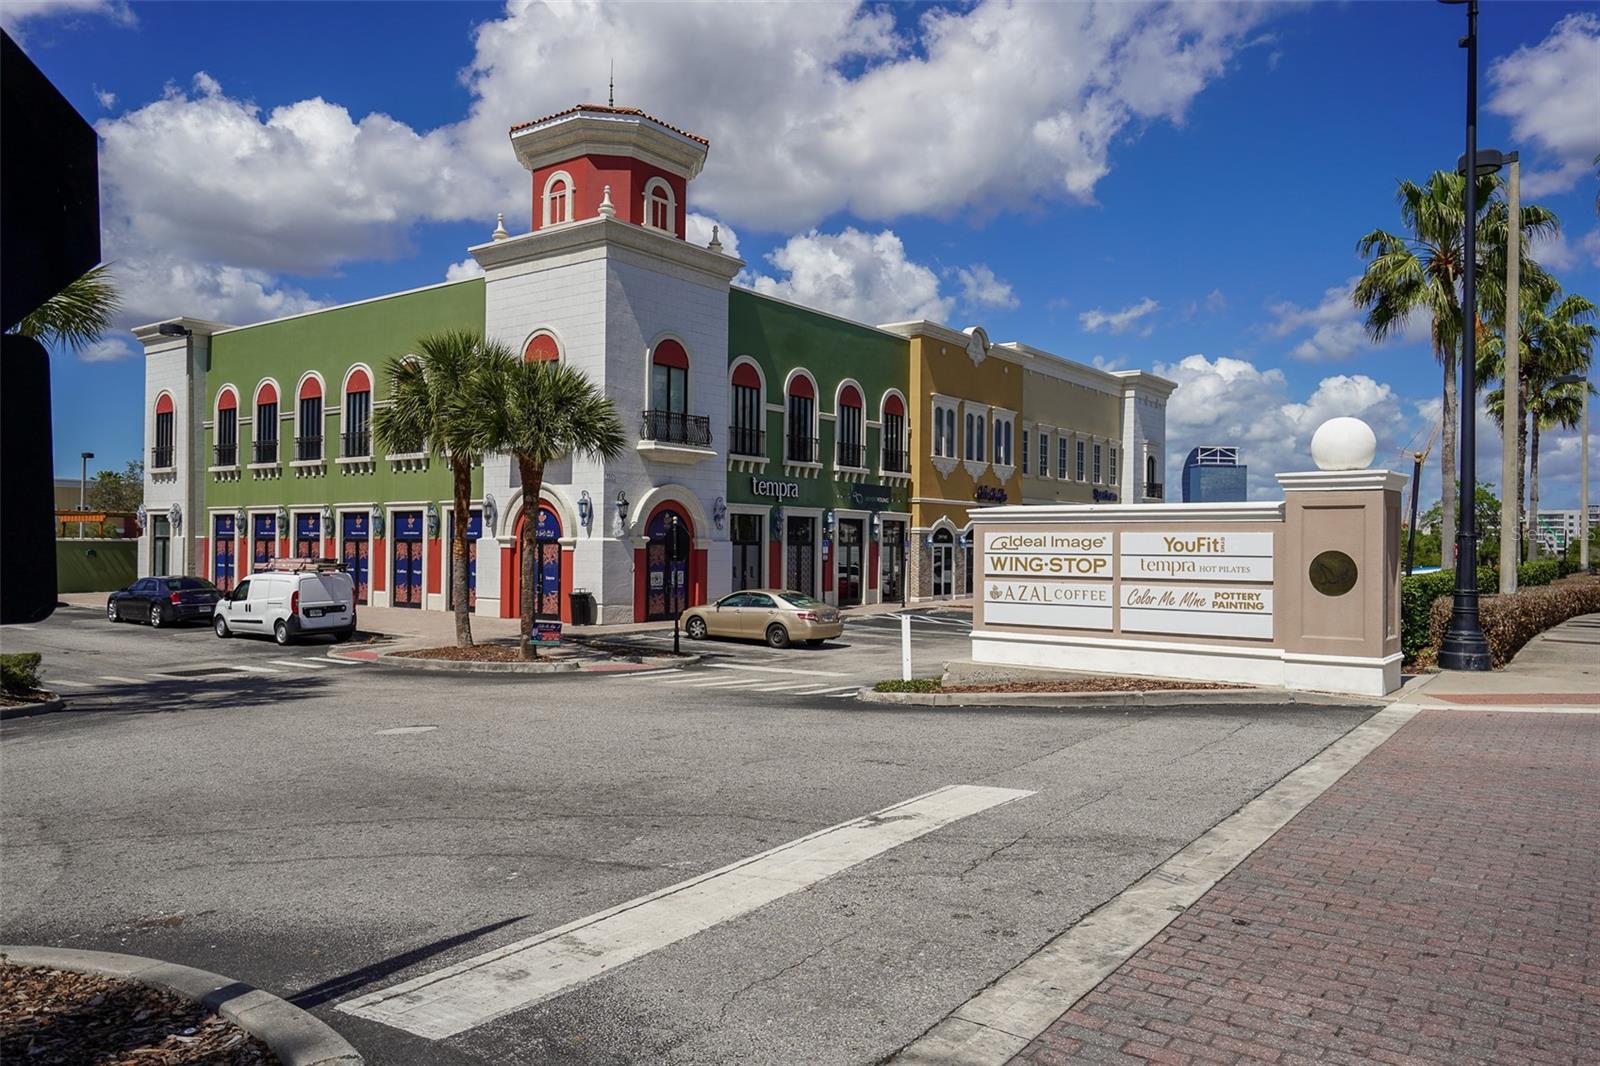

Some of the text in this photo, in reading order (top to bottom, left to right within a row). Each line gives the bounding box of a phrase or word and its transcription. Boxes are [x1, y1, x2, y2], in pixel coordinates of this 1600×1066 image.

[752, 476, 799, 502] tempra
[1009, 536, 1046, 548] Ideal
[1163, 536, 1220, 553] YouFit
[1140, 558, 1251, 576] tempra HOT PILATES
[1004, 585, 1107, 602] AZAL COFFEE
[1127, 588, 1207, 607] Color Me Mine
[1214, 591, 1262, 601] POTTERY
[1211, 601, 1265, 611] PAINTING
